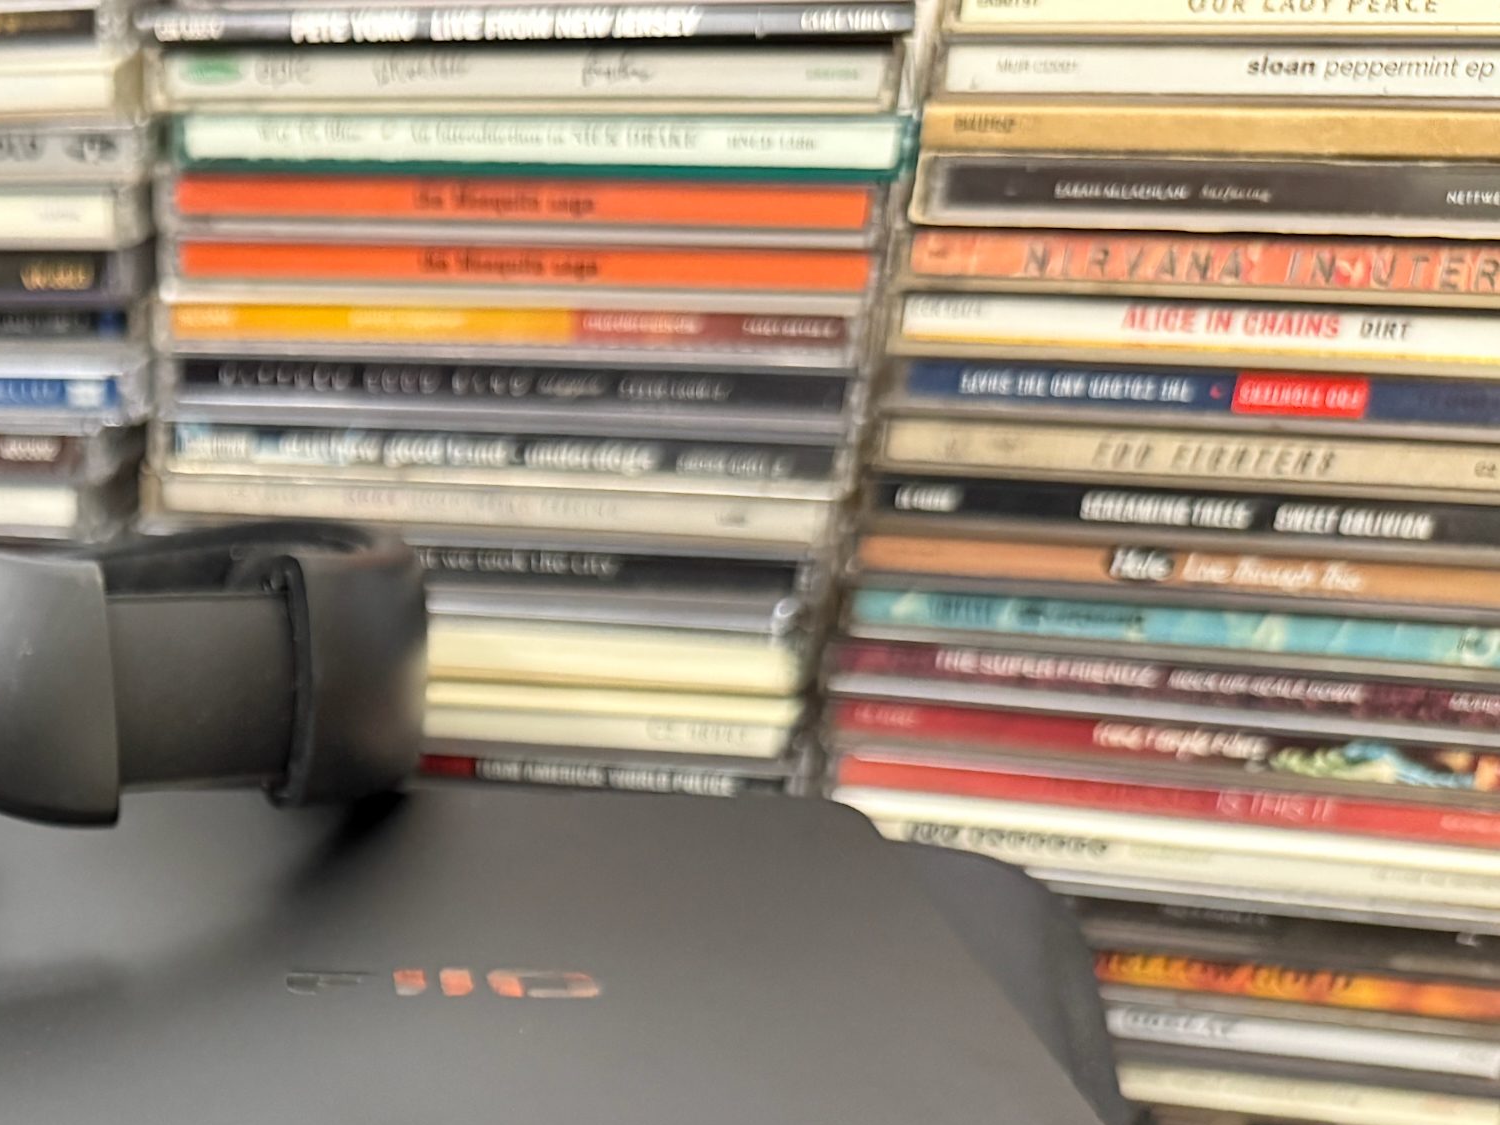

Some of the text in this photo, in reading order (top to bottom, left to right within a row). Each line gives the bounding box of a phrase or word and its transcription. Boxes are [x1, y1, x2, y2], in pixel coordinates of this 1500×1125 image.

[290, 8, 349, 43] PETE
[430, 7, 485, 42] LIVE
[485, 6, 553, 41] FROM
[553, 5, 614, 40] NEW
[612, 5, 700, 39] JERSEY
[1247, 55, 1495, 82] sloan peppermint ep
[1024, 242, 1244, 283] NIRVANA
[1284, 245, 1338, 285] IN
[1122, 307, 1413, 339] ALICE IN CHAINS DIRT
[1093, 438, 1337, 476] FOO FIGHTERS
[1080, 488, 1257, 530] SCREAMING TREES
[1273, 500, 1435, 541] SWEET OBLIVION
[607, 766, 671, 794] WORLD
[672, 770, 738, 798] POLICE
